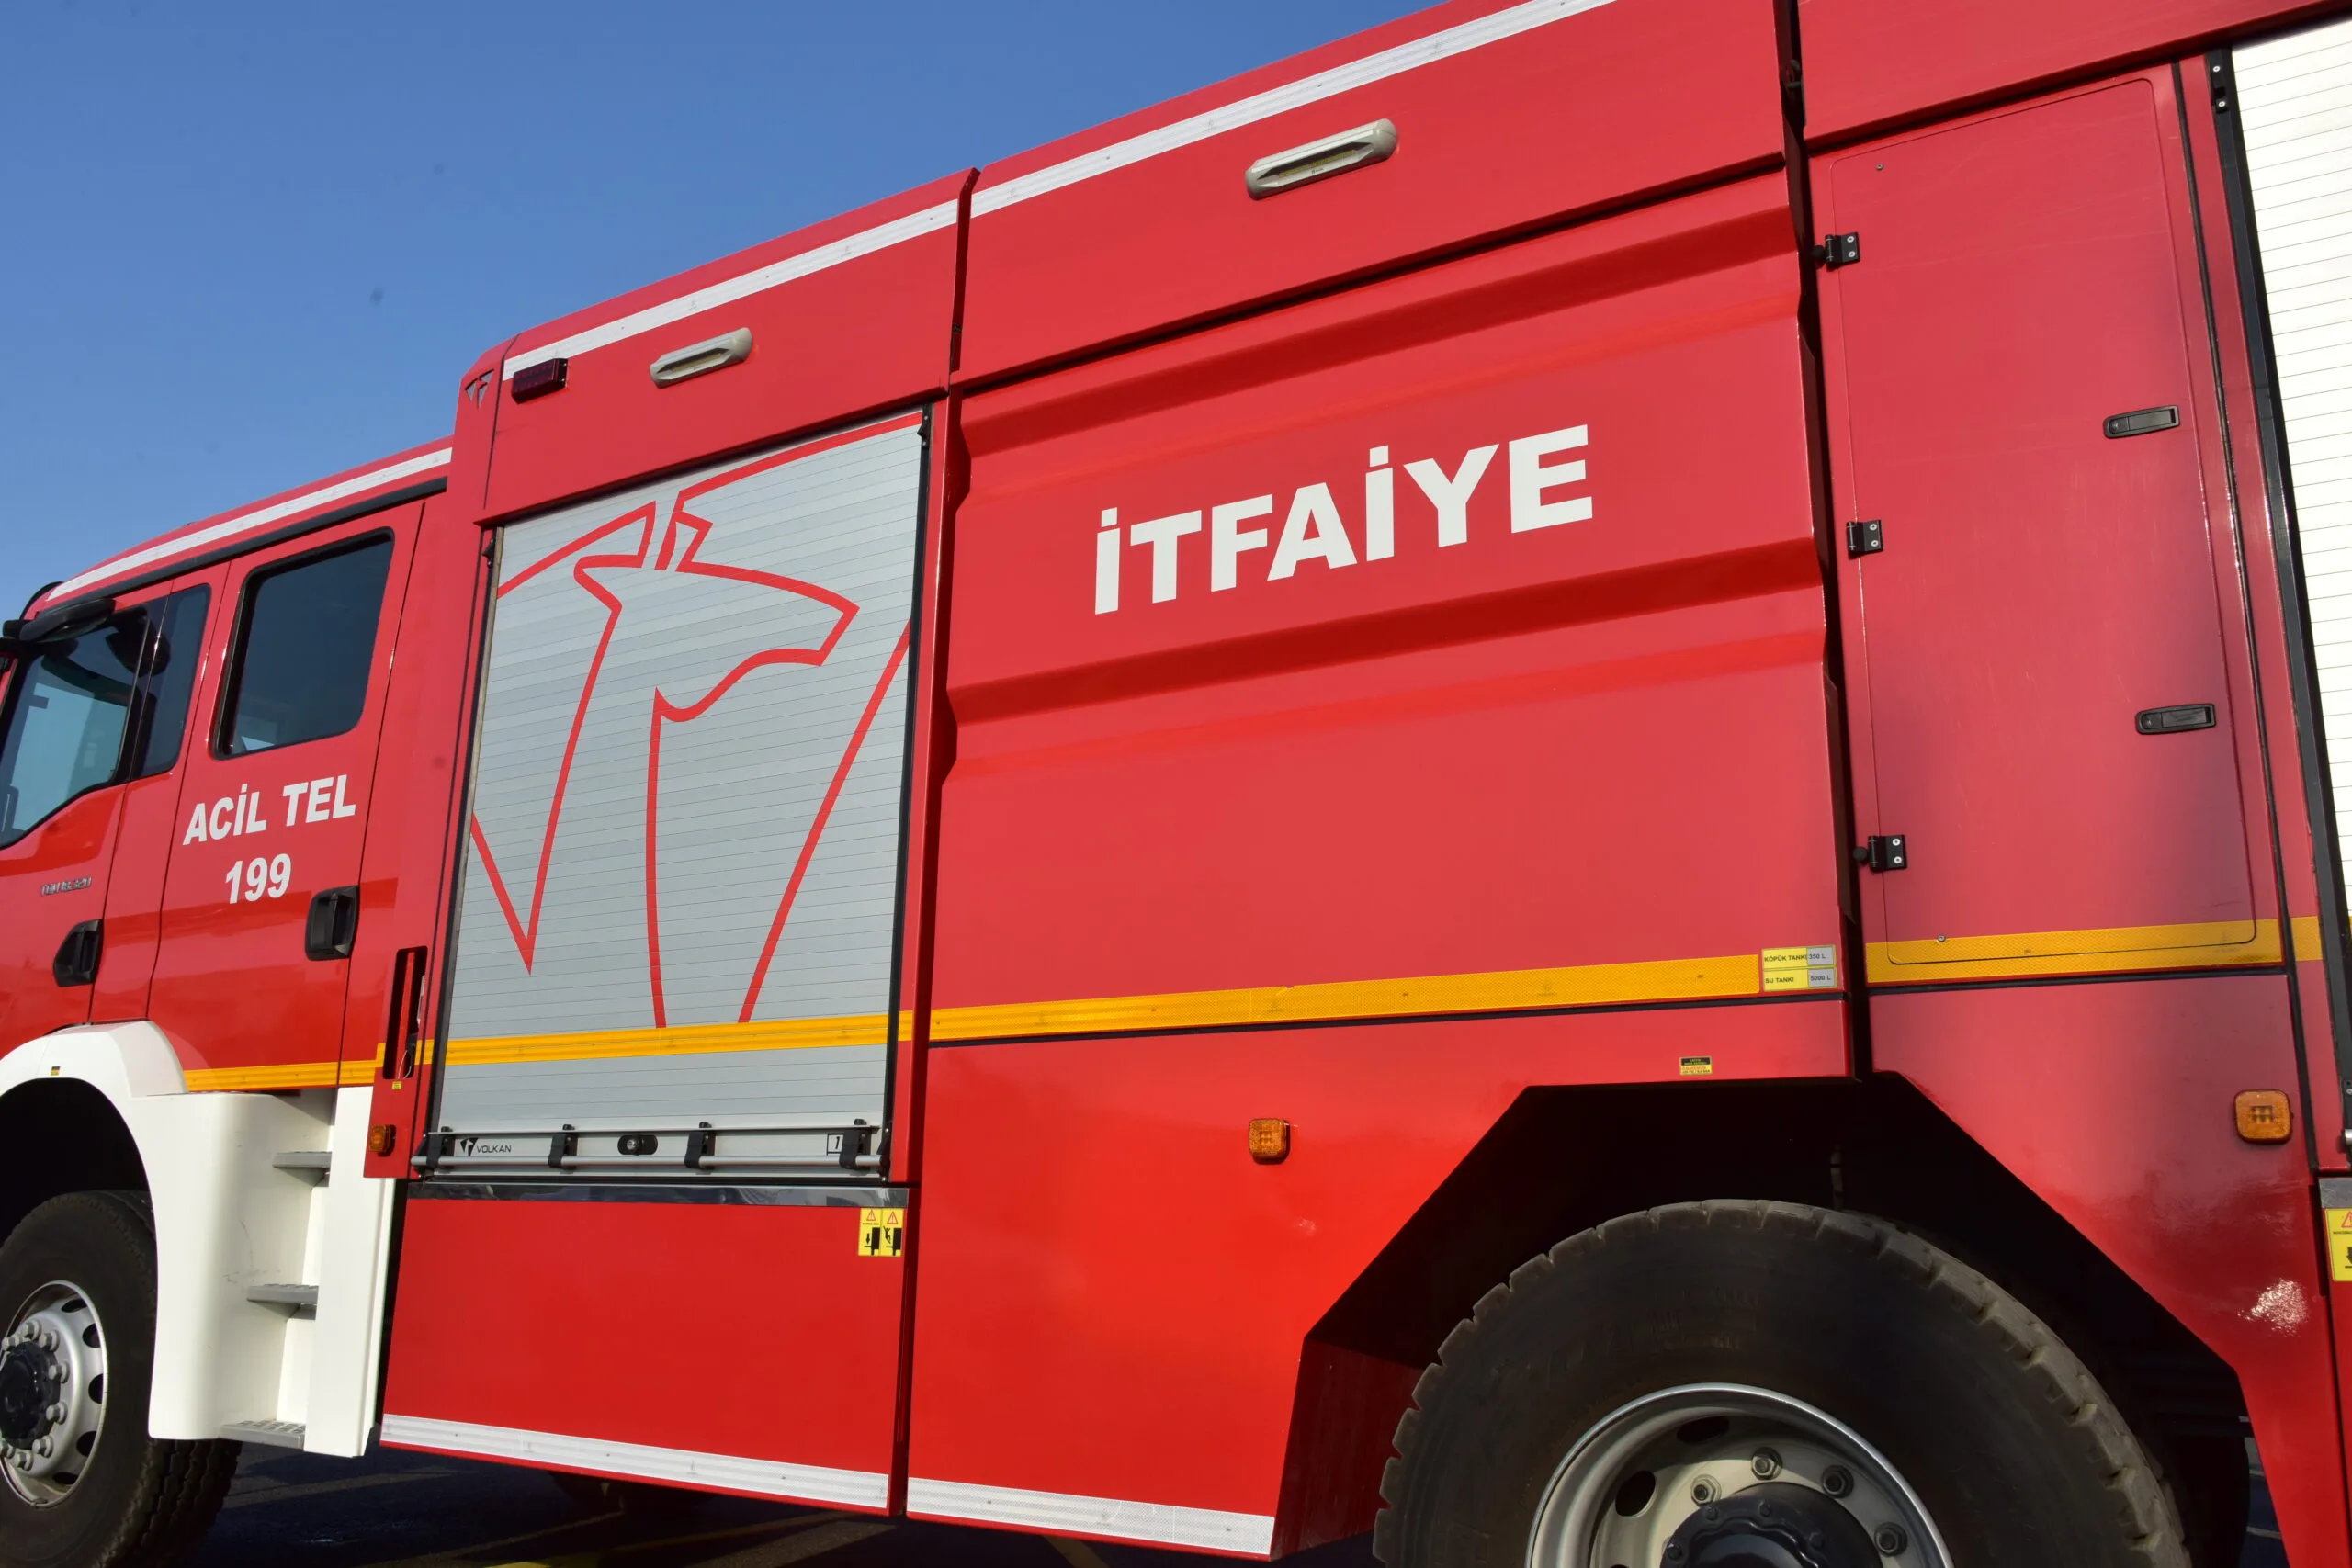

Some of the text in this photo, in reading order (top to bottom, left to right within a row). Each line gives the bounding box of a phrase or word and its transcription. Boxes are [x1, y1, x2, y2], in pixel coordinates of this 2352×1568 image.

[1094, 424, 1593, 615] İTFAİYE
[182, 774, 356, 846] ACİL TEL
[225, 853, 292, 905] 199
[476, 1145, 512, 1154] VOLKAN
